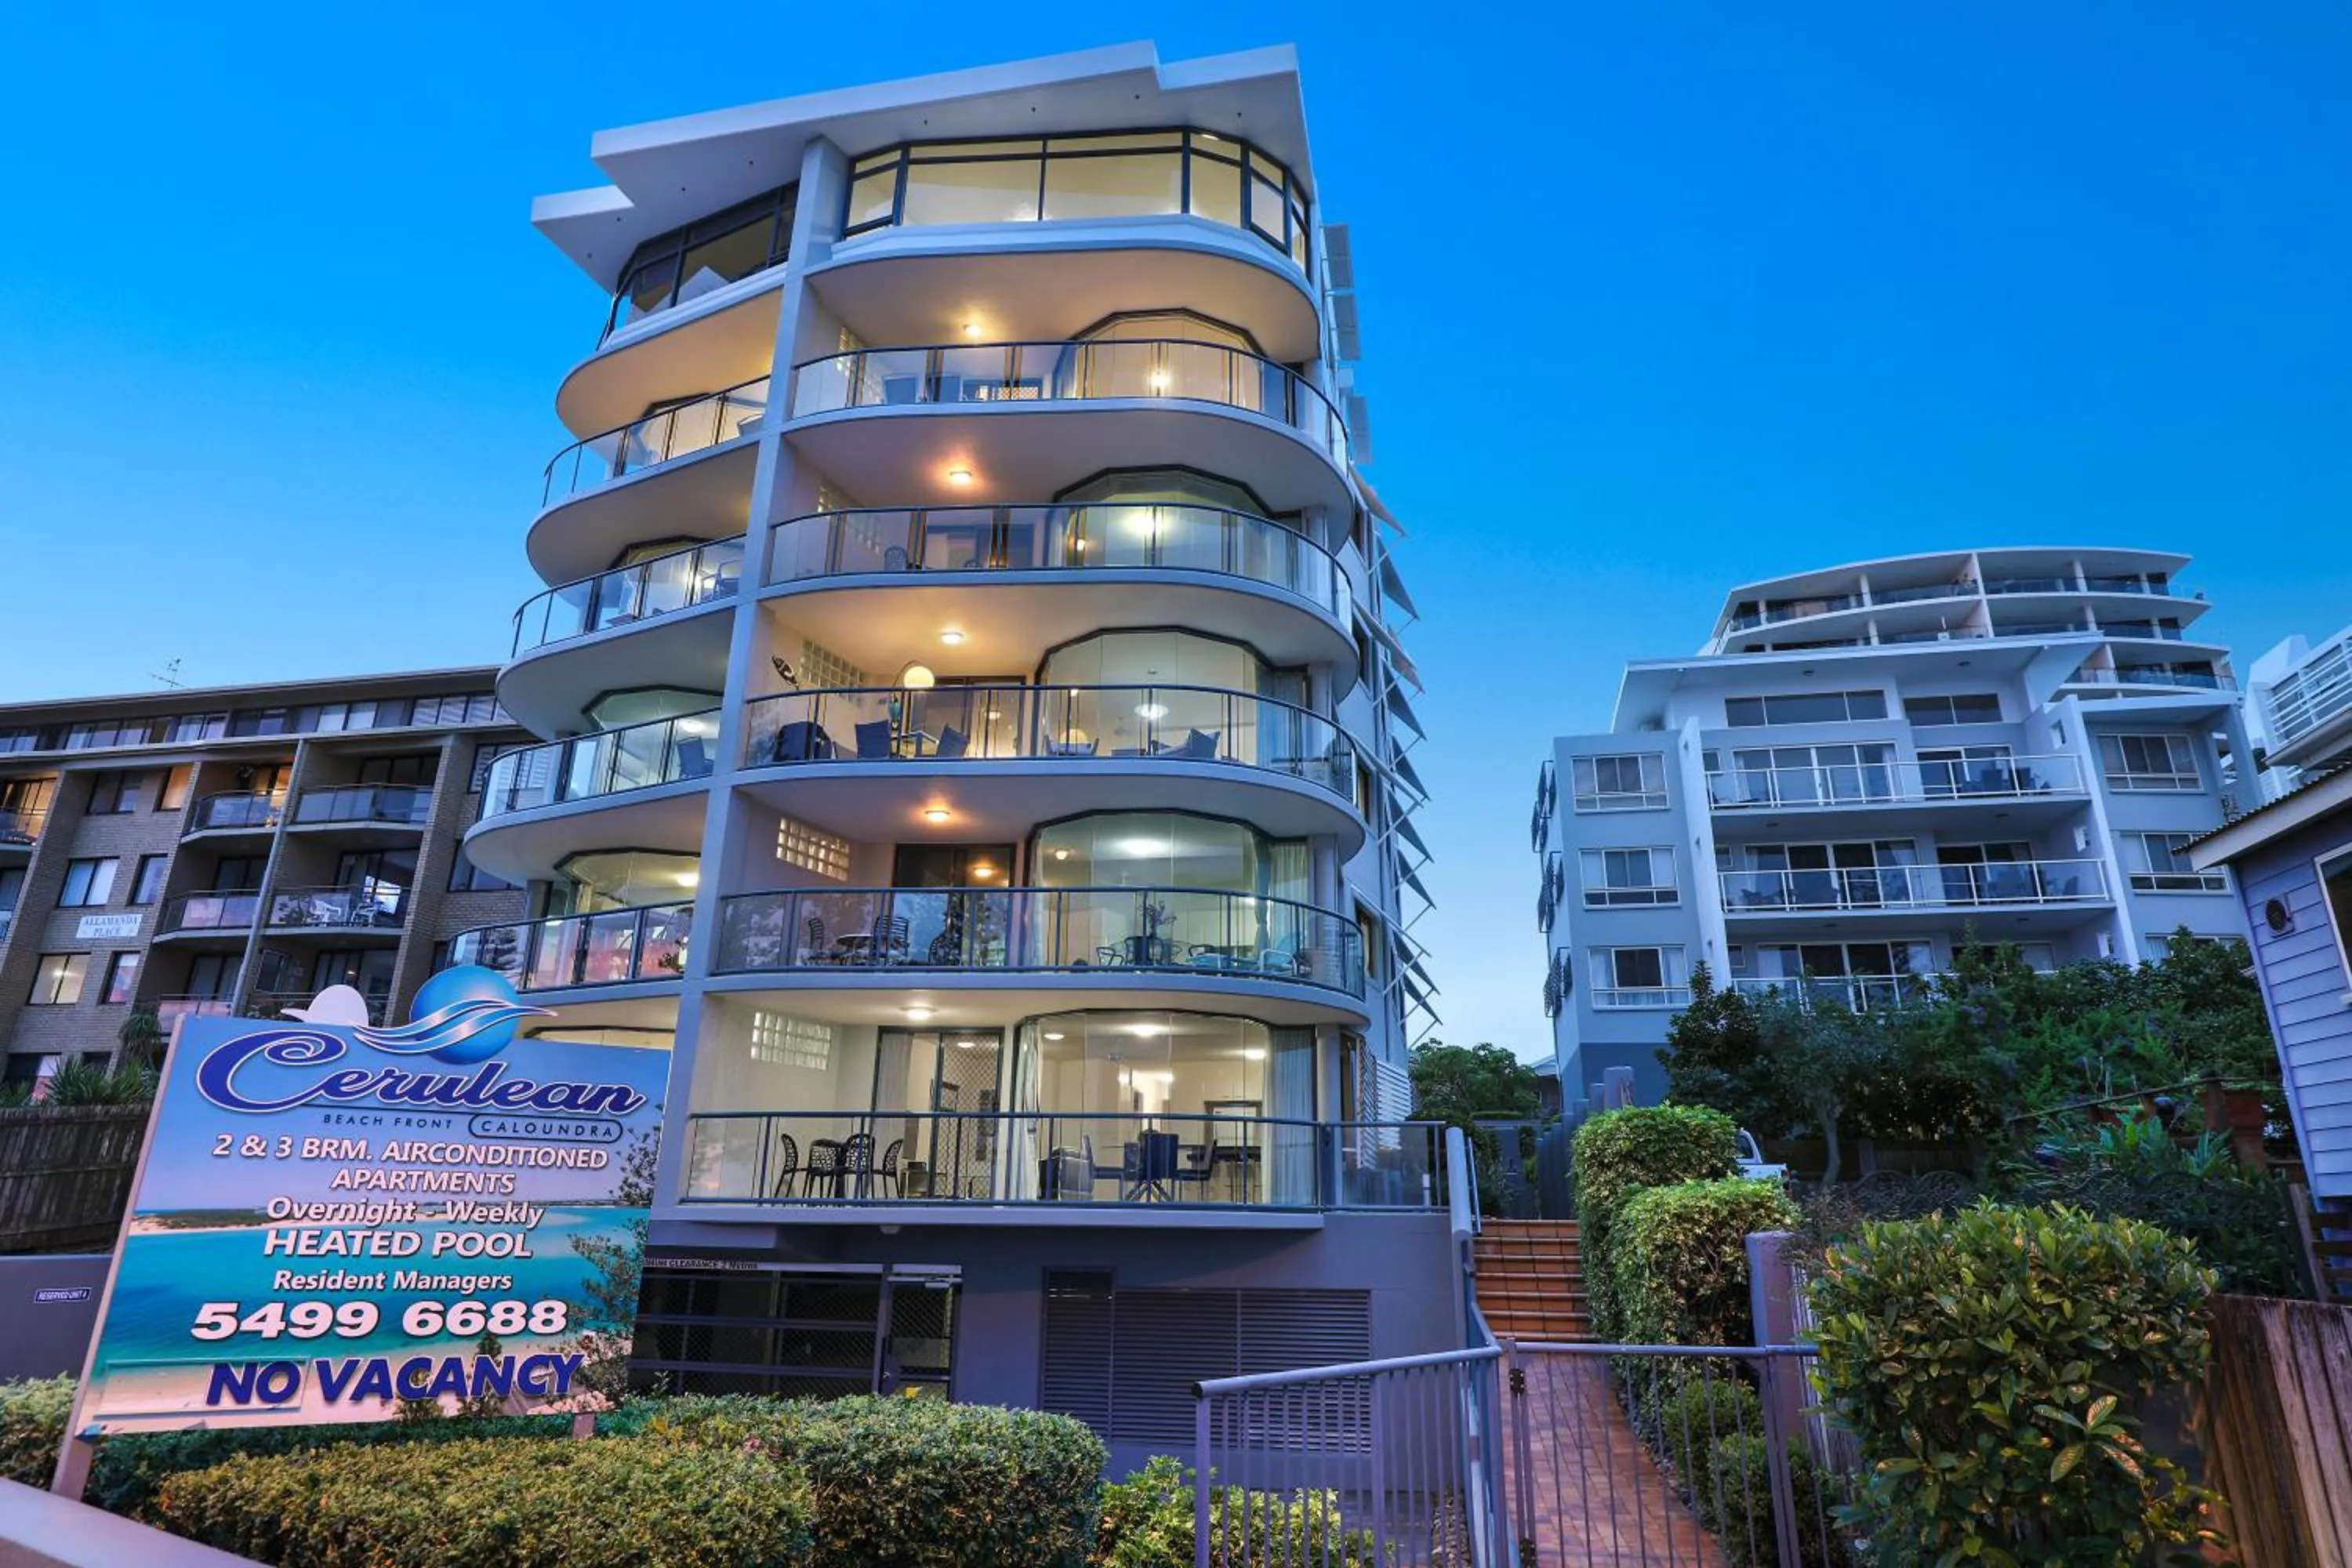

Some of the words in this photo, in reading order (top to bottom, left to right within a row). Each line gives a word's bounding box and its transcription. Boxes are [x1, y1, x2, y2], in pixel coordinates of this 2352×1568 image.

[197, 1029, 647, 1113] Cerulean
[324, 1114, 383, 1126] BEACH
[394, 1117, 452, 1129] FRONT
[481, 1120, 612, 1138] CALOUNDRA
[212, 1134, 233, 1156] 2
[241, 1134, 267, 1157] &
[275, 1135, 293, 1159] 3
[300, 1137, 373, 1160] BRM.
[380, 1141, 608, 1169] AIRCONDITIONED
[330, 1168, 516, 1194] APARTMENTS
[267, 1196, 418, 1229] Overnight
[446, 1200, 545, 1229] Weekly
[263, 1229, 423, 1258] HEATED
[432, 1232, 534, 1258] POOL
[272, 1269, 386, 1291] Resident
[393, 1270, 513, 1295] Managers
[191, 1300, 380, 1341] 5499
[401, 1299, 568, 1338] 6688
[205, 1359, 302, 1406] NO
[314, 1352, 586, 1403] VACANCY
